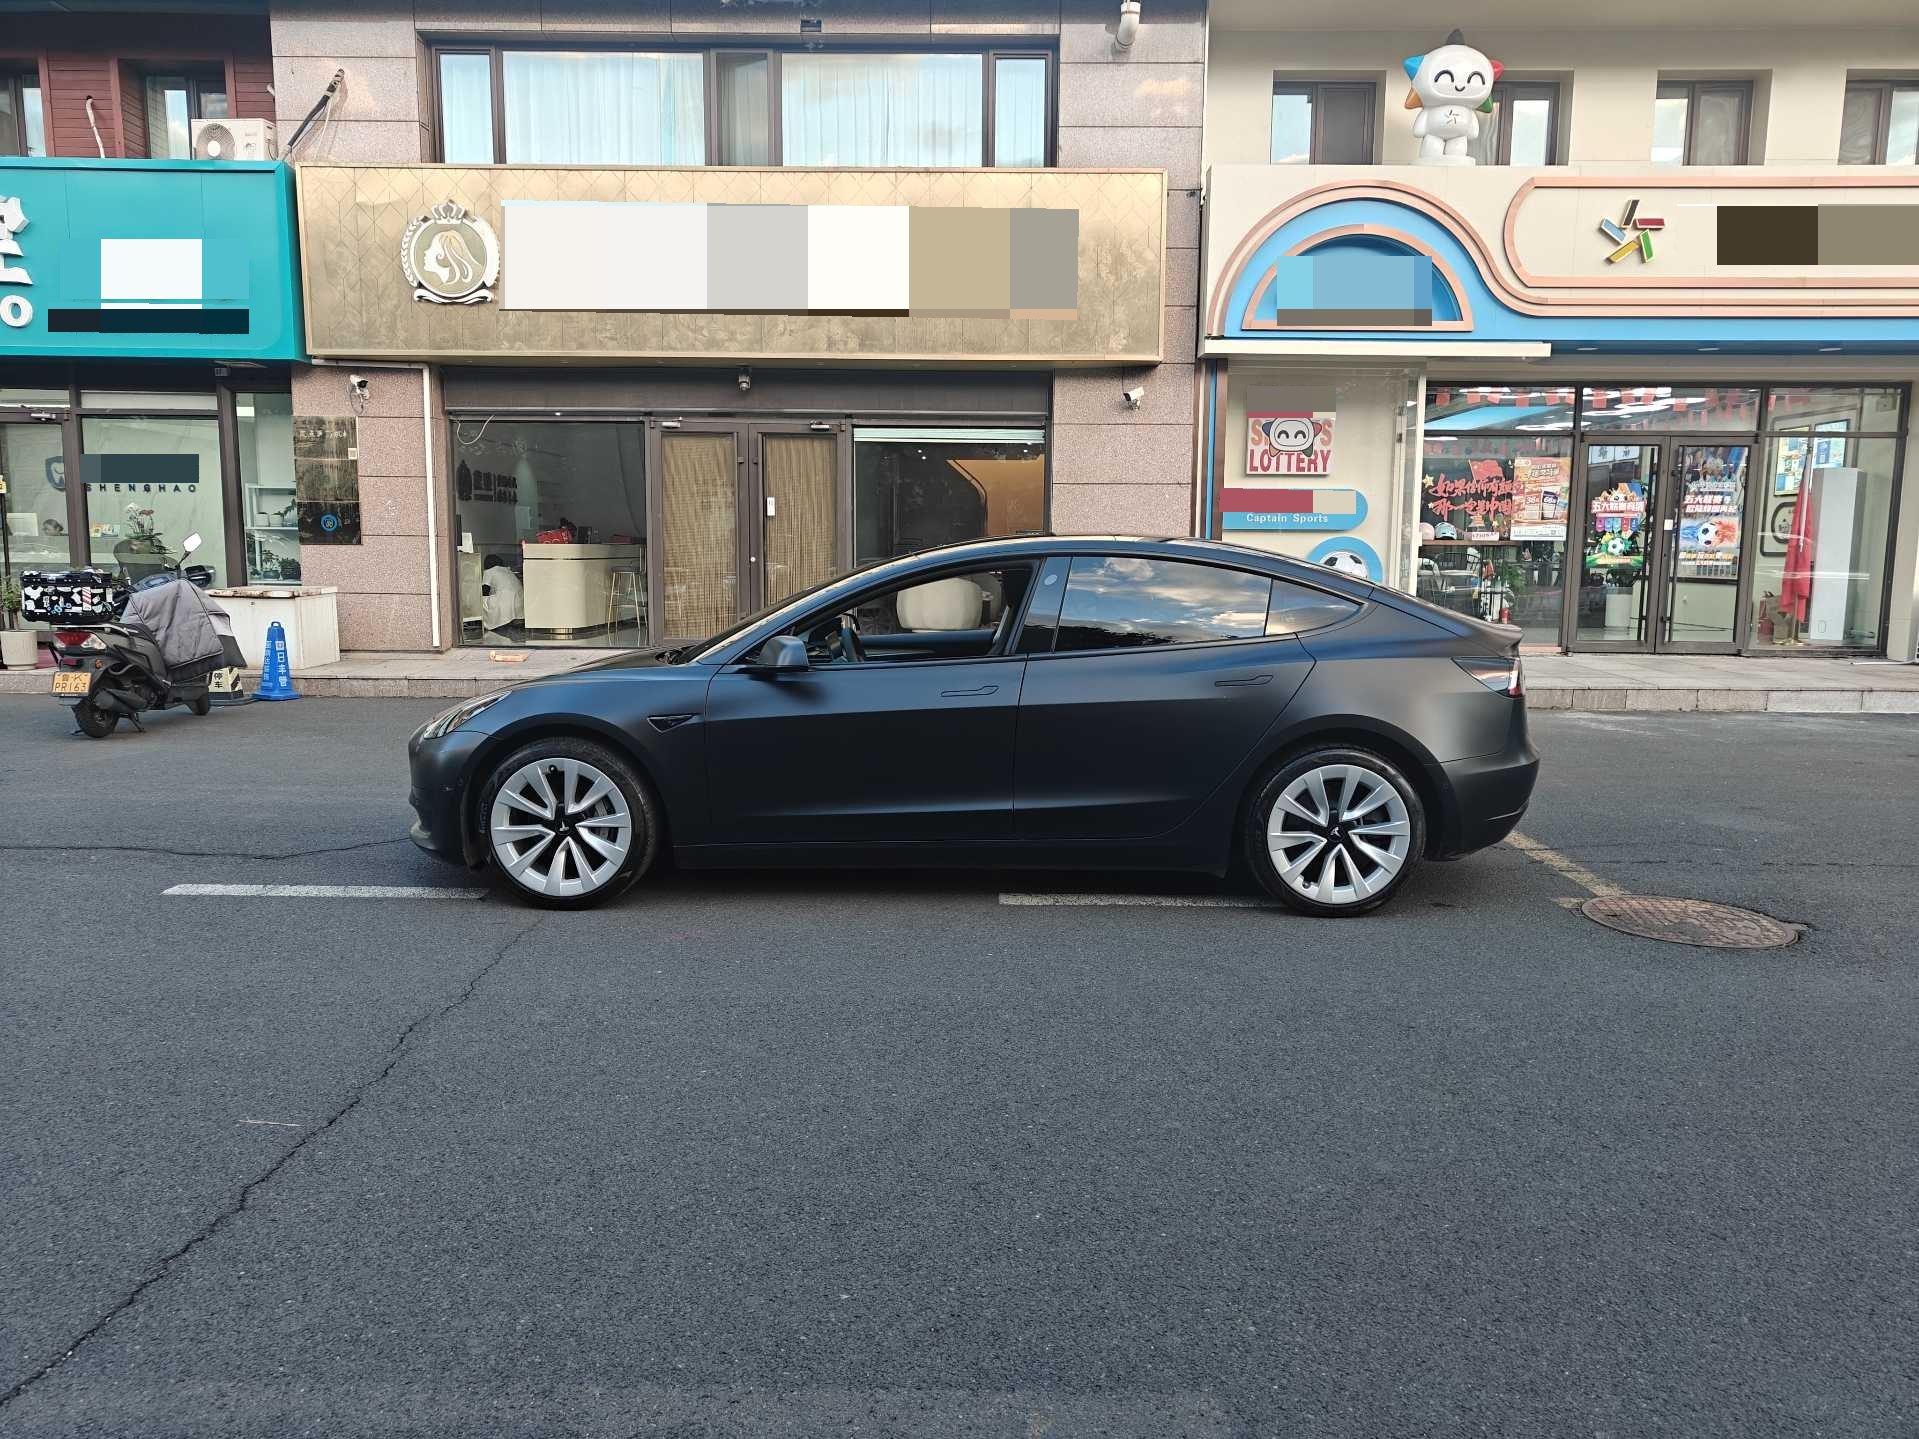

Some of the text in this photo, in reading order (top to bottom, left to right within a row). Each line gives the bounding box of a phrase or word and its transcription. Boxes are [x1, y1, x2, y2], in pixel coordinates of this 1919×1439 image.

[1248, 449, 1332, 473] LOTTERY
[85, 484, 197, 493] SHENGHAO
[1246, 513, 1329, 524] Captain Sports
